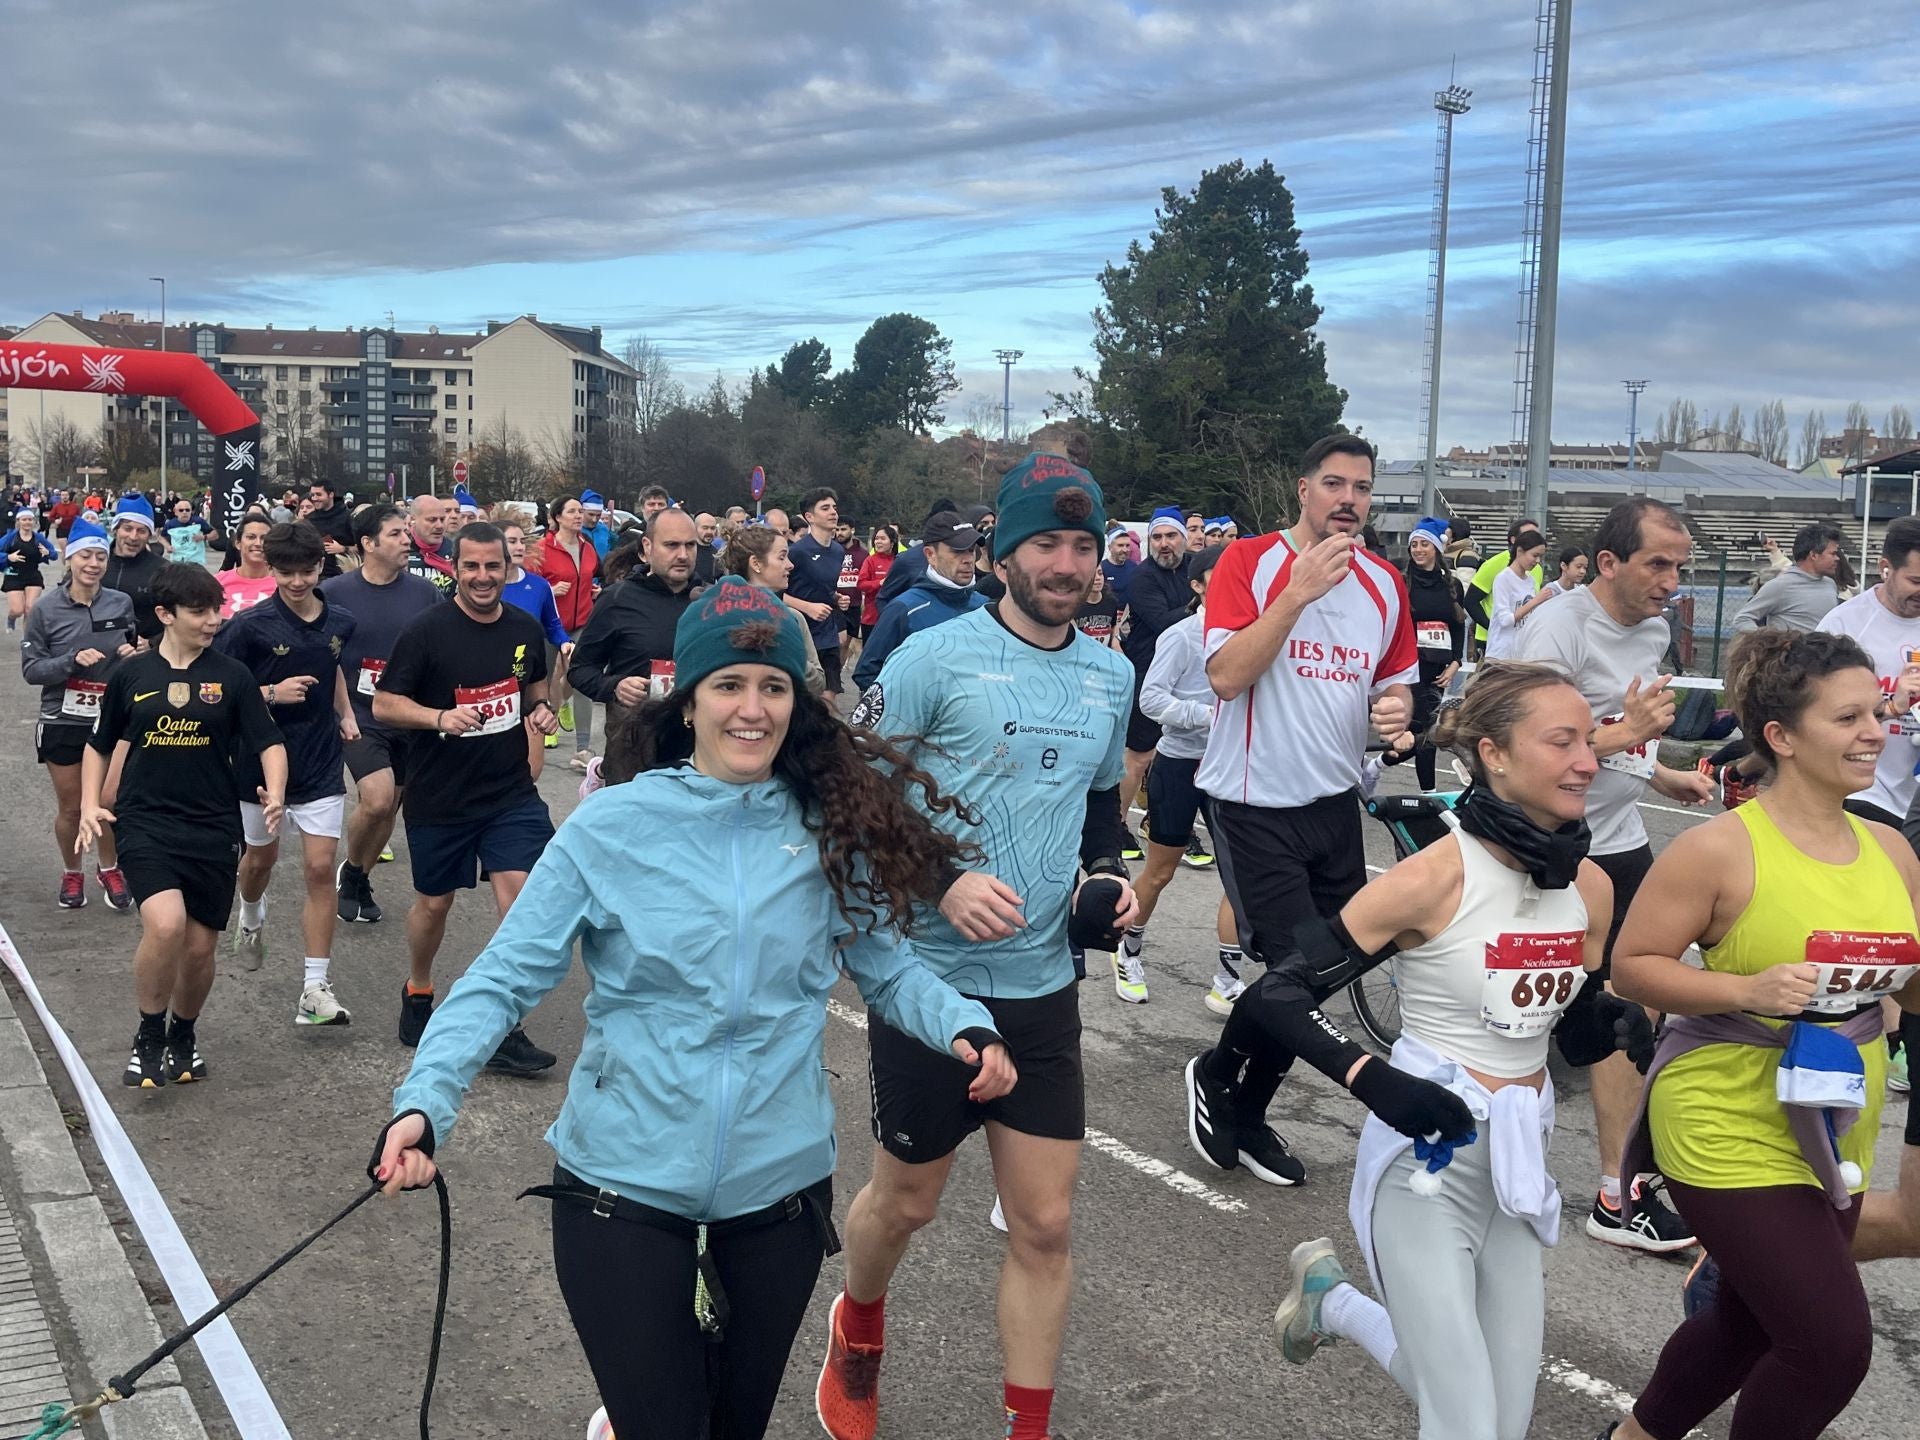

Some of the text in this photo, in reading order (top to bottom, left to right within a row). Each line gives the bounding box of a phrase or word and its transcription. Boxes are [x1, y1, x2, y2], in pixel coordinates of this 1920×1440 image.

[1427, 631, 1445, 641] 181
[1289, 639, 1325, 662] IES
[1296, 667, 1360, 684] GIJÓN
[156, 715, 201, 735] Qatar
[142, 732, 210, 748] Foundation
[1401, 799, 1419, 807] THULE
[1512, 938, 1524, 947] 37
[1546, 948, 1555, 956] de
[1867, 946, 1878, 954] de
[1520, 959, 1573, 968] Nochebuena
[1840, 954, 1897, 964] Nochebuena
[1511, 971, 1575, 1008] 698
